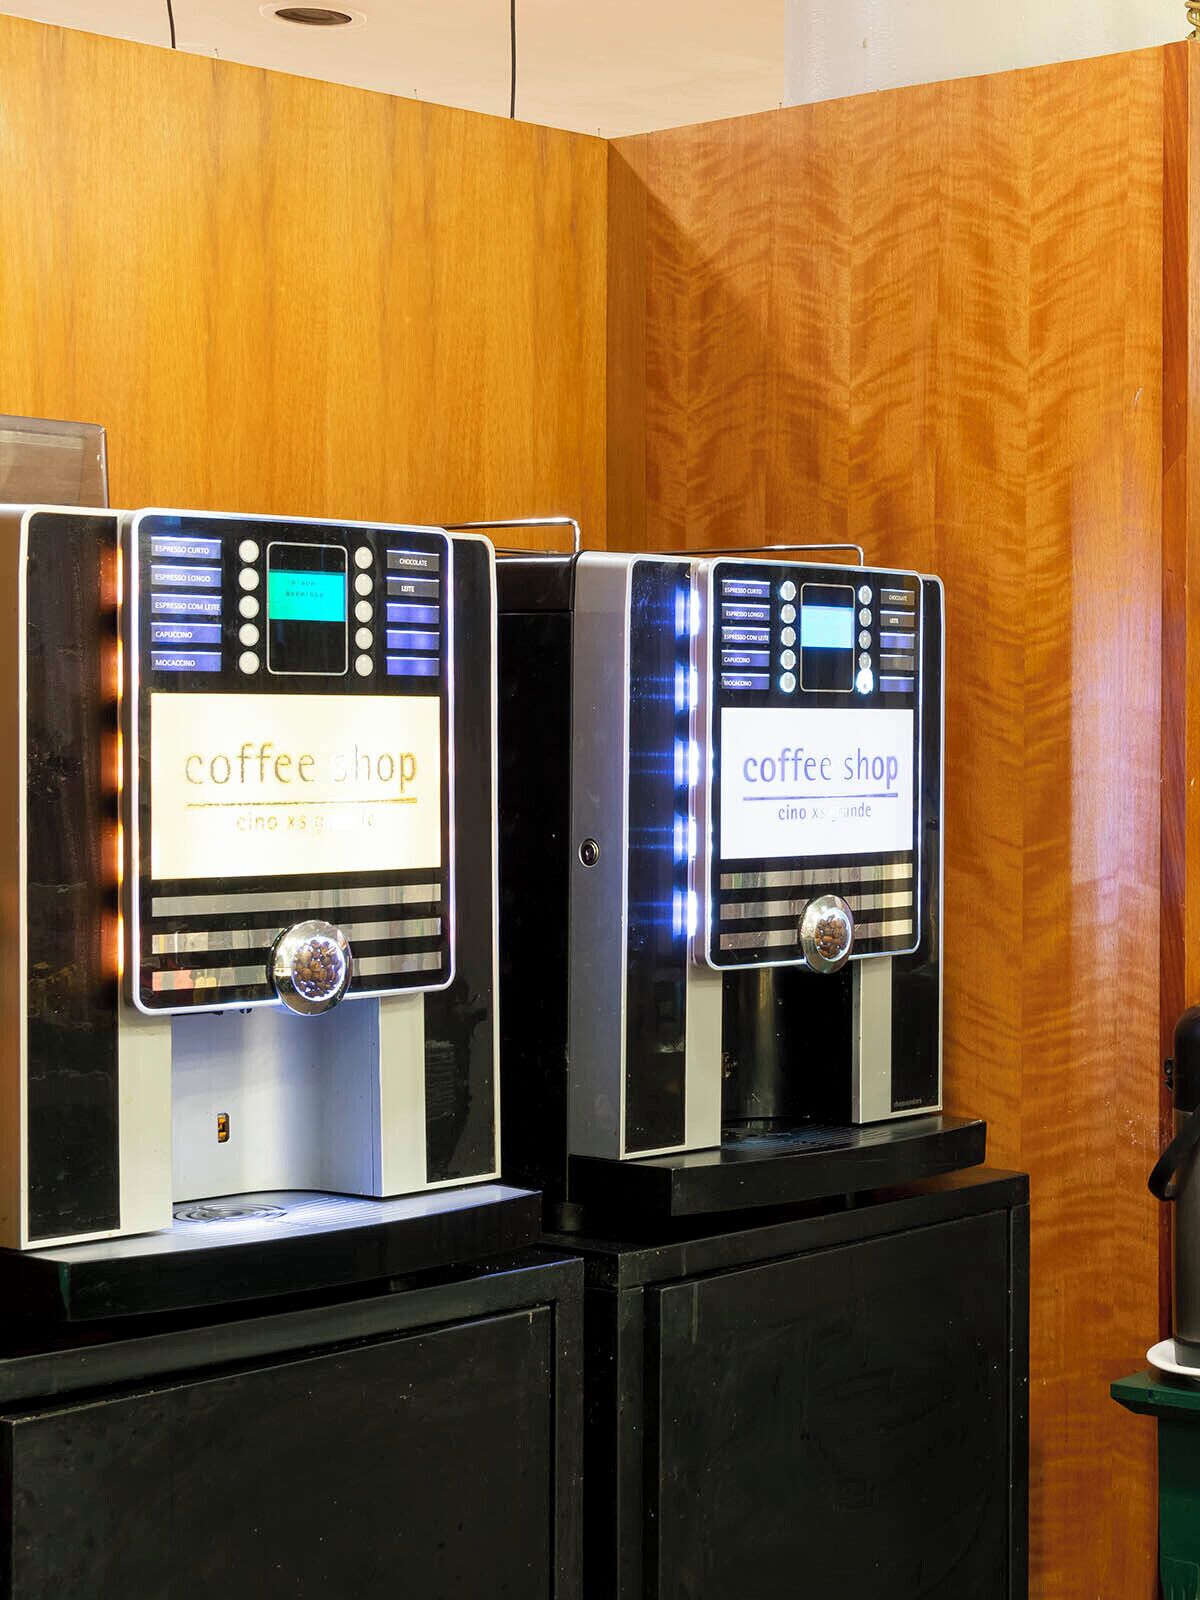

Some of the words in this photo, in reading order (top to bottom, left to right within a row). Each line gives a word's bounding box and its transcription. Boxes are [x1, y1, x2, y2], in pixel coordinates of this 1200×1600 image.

[155, 545, 187, 554] ESPRESSO
[187, 546, 210, 555] CURTO
[399, 558, 428, 567] CHOCOLATE
[155, 573, 187, 582] ESPRESSO
[187, 574, 211, 583] LONGO
[401, 585, 415, 593] LEITE
[155, 602, 187, 610] ESPRESSO
[187, 602, 204, 611] COM
[204, 603, 220, 611] LEITE
[155, 659, 196, 667] MOCACCINO
[185, 741, 315, 785] coffee
[334, 743, 417, 794] shop
[743, 747, 832, 783] coffee
[843, 747, 898, 790] shop
[777, 804, 807, 821] cino
